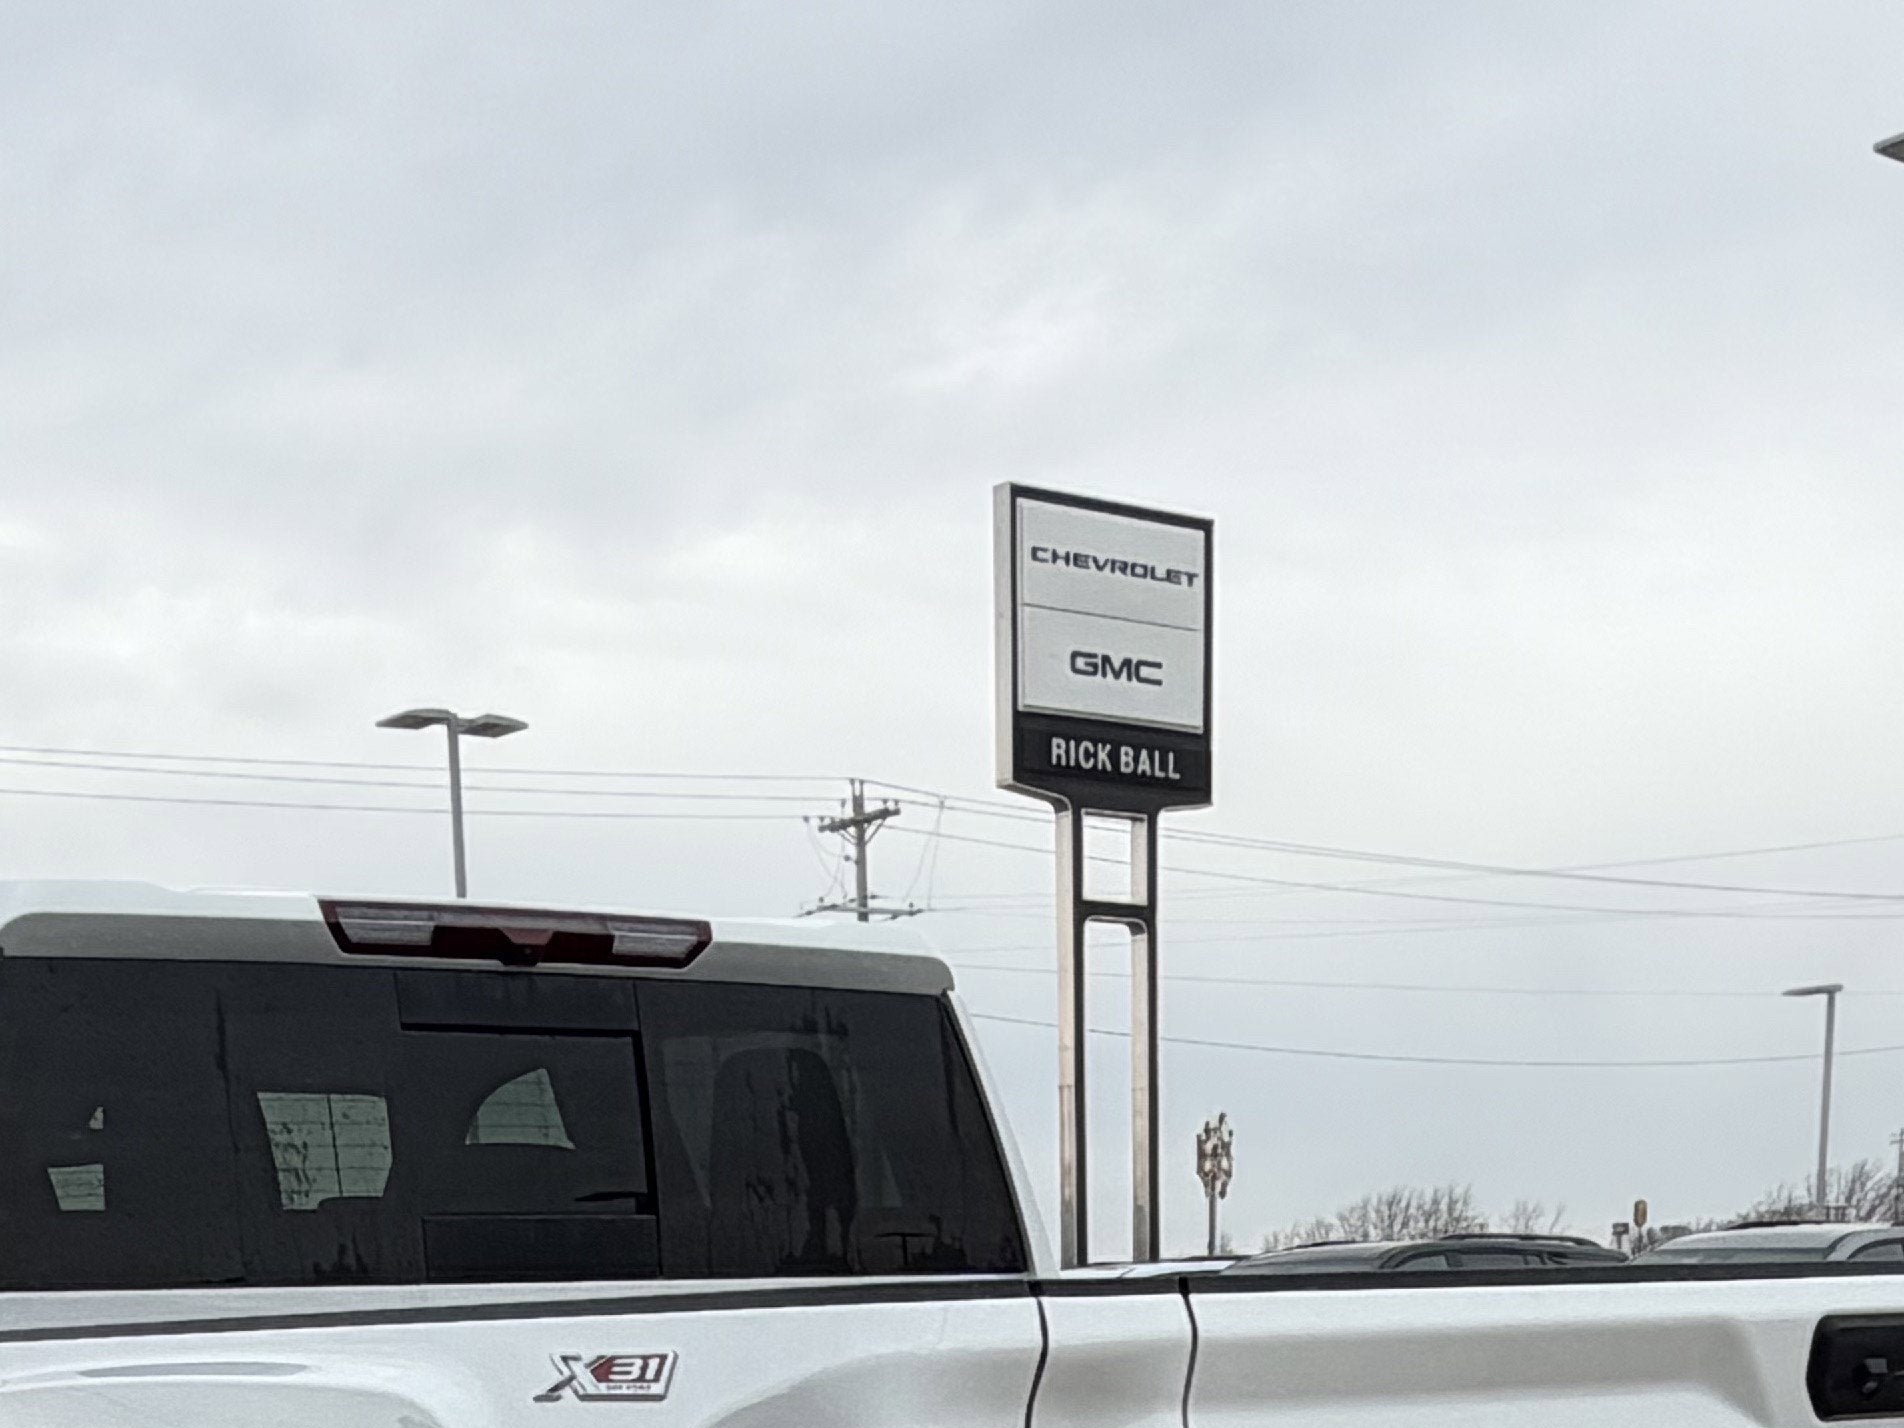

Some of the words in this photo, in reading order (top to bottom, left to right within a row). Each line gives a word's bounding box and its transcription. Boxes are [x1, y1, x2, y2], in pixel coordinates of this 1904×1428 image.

[1030, 546, 1199, 587] CHEVROLET
[1070, 650, 1163, 686] GMC
[1051, 737, 1112, 772] RICK
[1119, 746, 1181, 780] BALL
